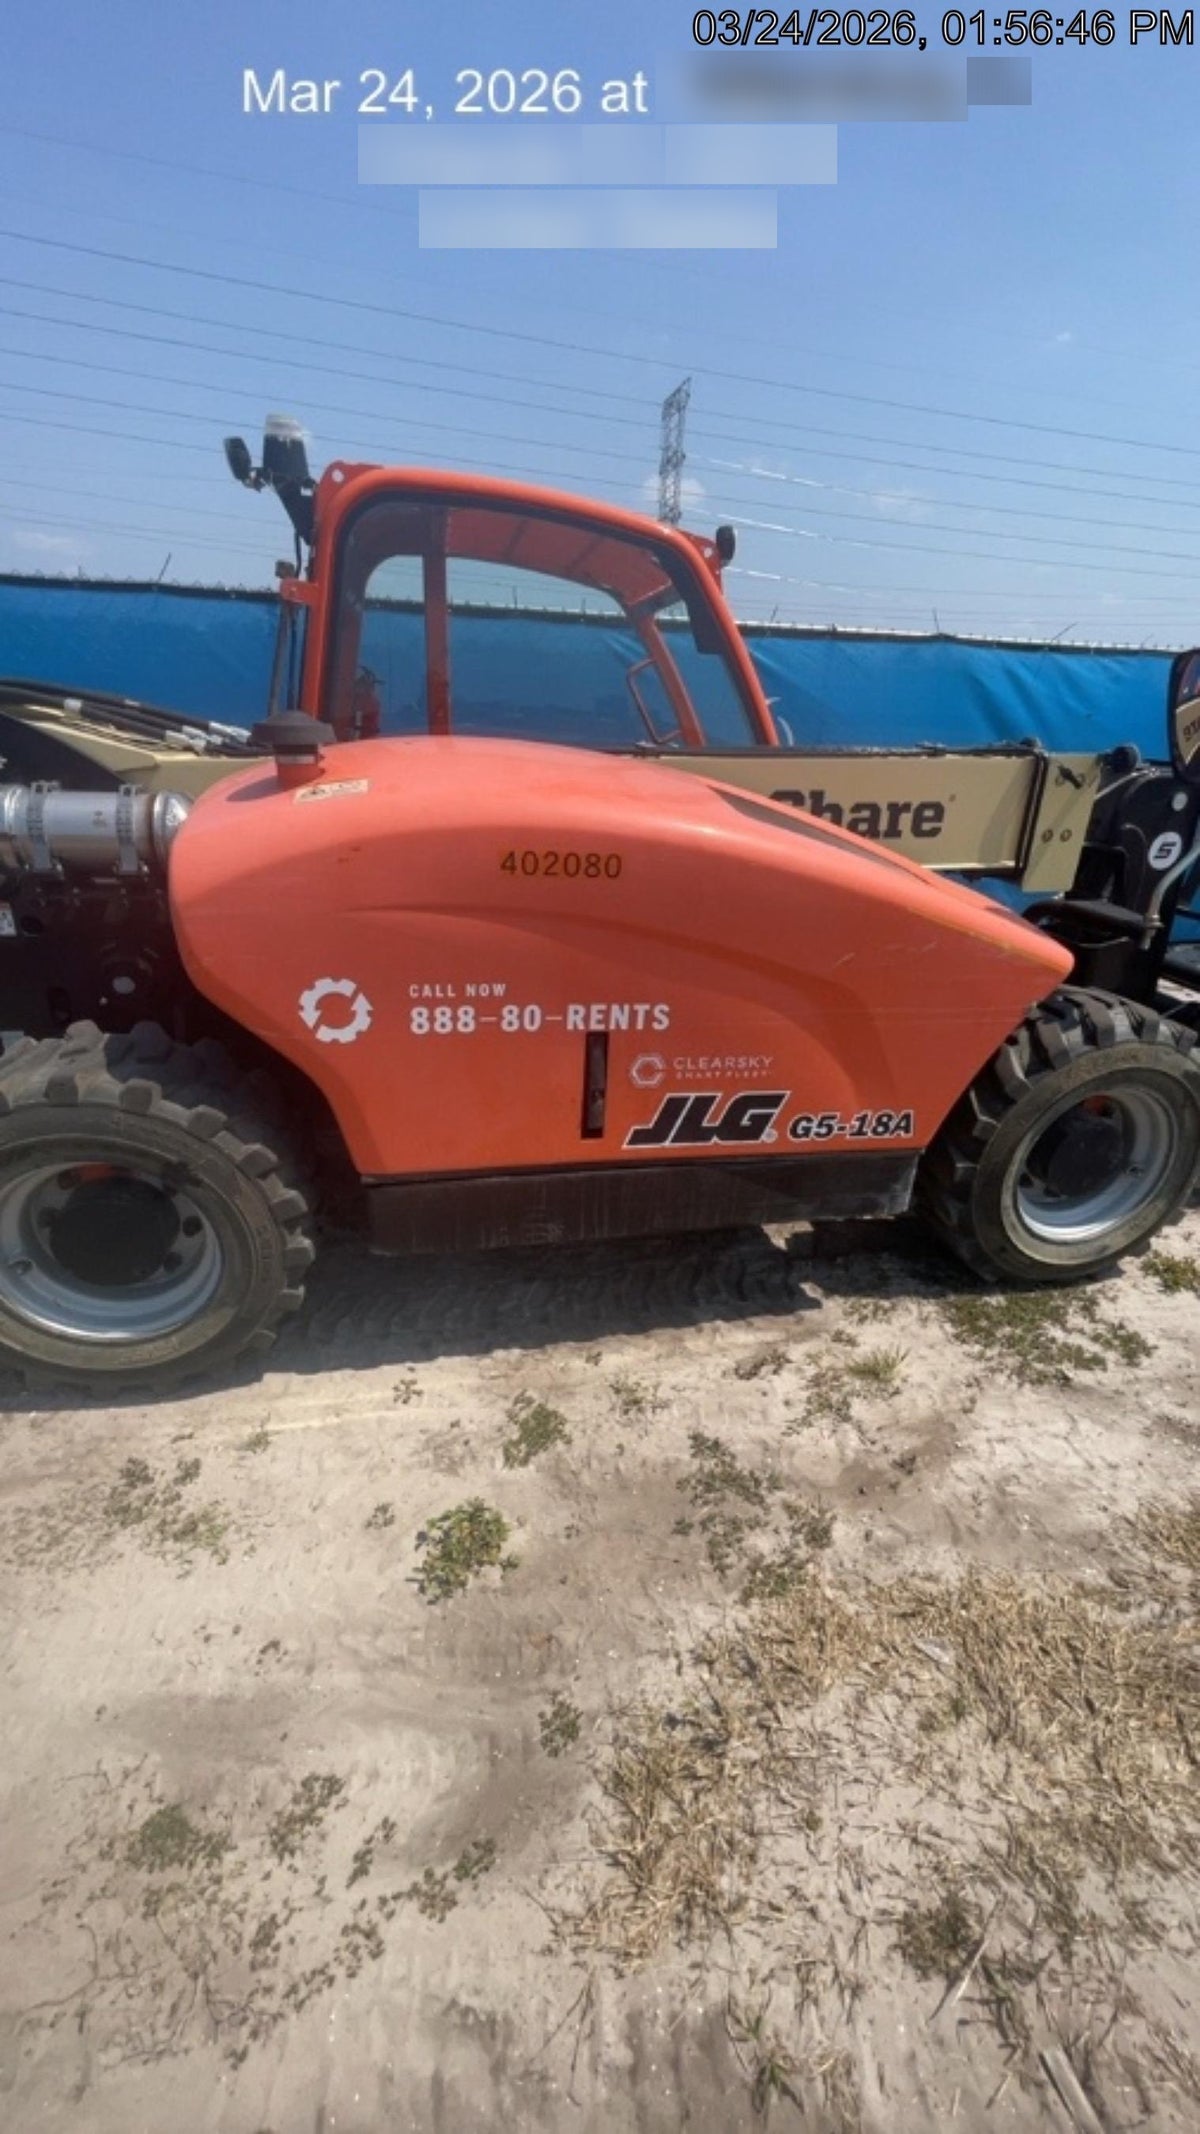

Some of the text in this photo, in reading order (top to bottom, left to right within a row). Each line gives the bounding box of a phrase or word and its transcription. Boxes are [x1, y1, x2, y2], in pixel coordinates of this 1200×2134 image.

[769, 789, 945, 838] hare
[500, 850, 622, 879] 402080
[409, 983, 507, 998] CALL NOW
[410, 1003, 670, 1035] 888-80-RENTS
[673, 1056, 774, 1070] CLEARSKY
[622, 1090, 790, 1148] JLG
[787, 1109, 914, 1141] G5-18A
